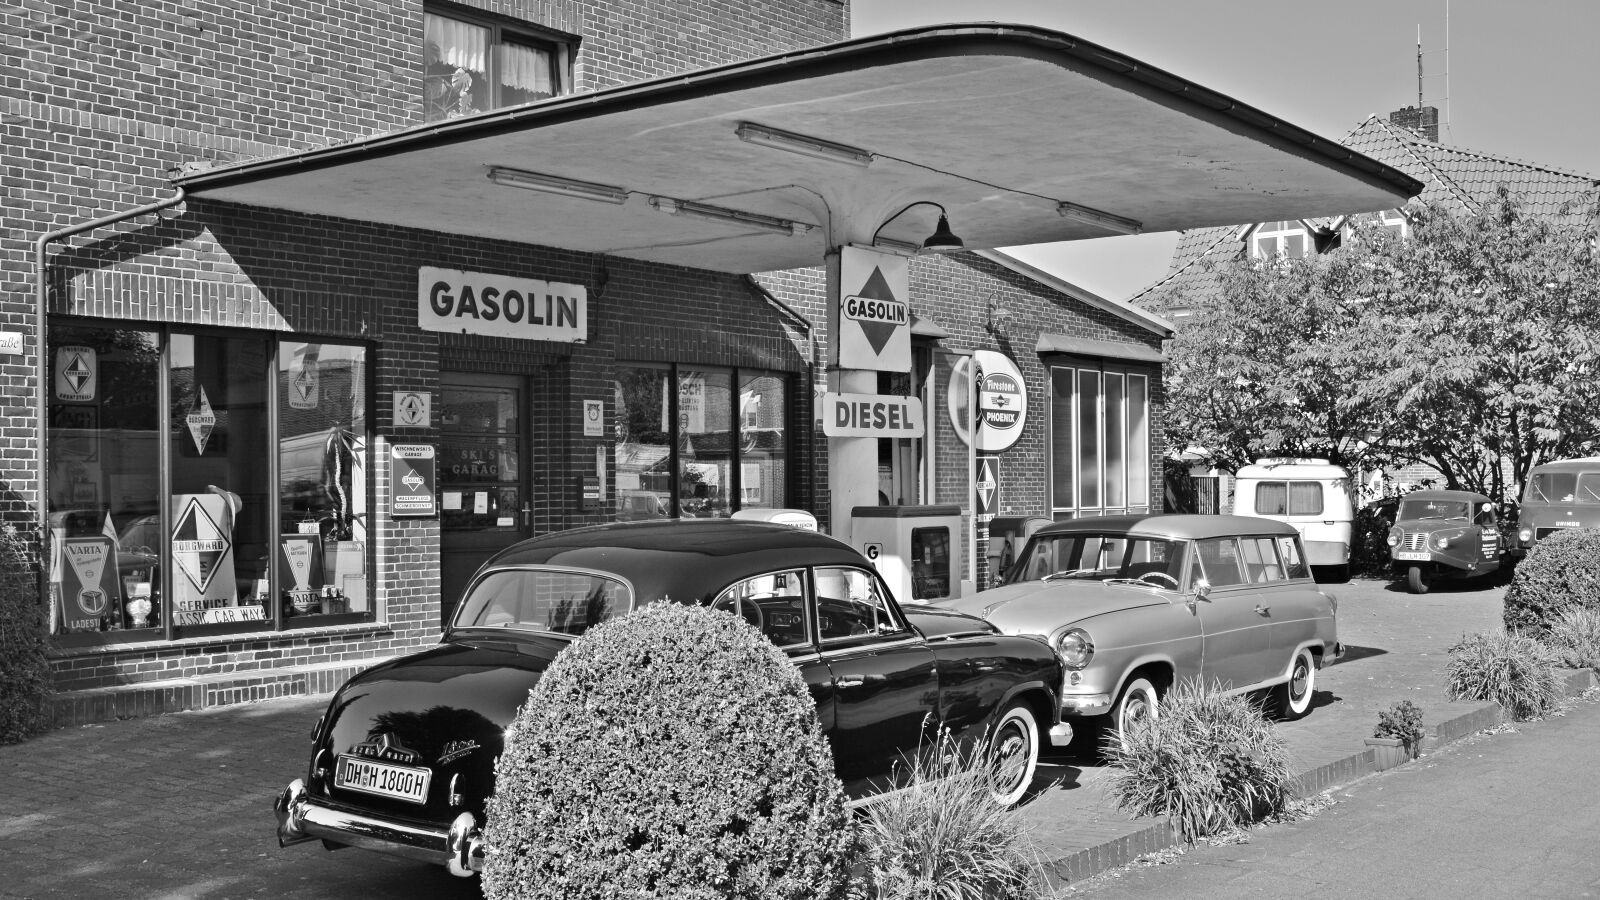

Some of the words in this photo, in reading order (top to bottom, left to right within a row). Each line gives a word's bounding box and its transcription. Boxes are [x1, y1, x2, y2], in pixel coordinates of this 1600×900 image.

[430, 281, 578, 329] GASOLIN
[847, 299, 905, 322] GASOLIN
[0, 336, 19, 348] aße
[679, 383, 702, 395] SCH
[835, 401, 914, 429] DIESEL
[986, 411, 1016, 423] PHOENIX
[452, 464, 498, 475] GARAG
[69, 545, 102, 555] VARTA
[171, 540, 224, 552] BORGWARD
[293, 593, 321, 604] ARTA
[180, 599, 228, 612] SERVICE
[178, 611, 208, 625] ASSIC
[214, 609, 234, 621] CAR
[71, 619, 101, 629] LADEST
[345, 762, 363, 785] DH
[368, 766, 379, 788] H
